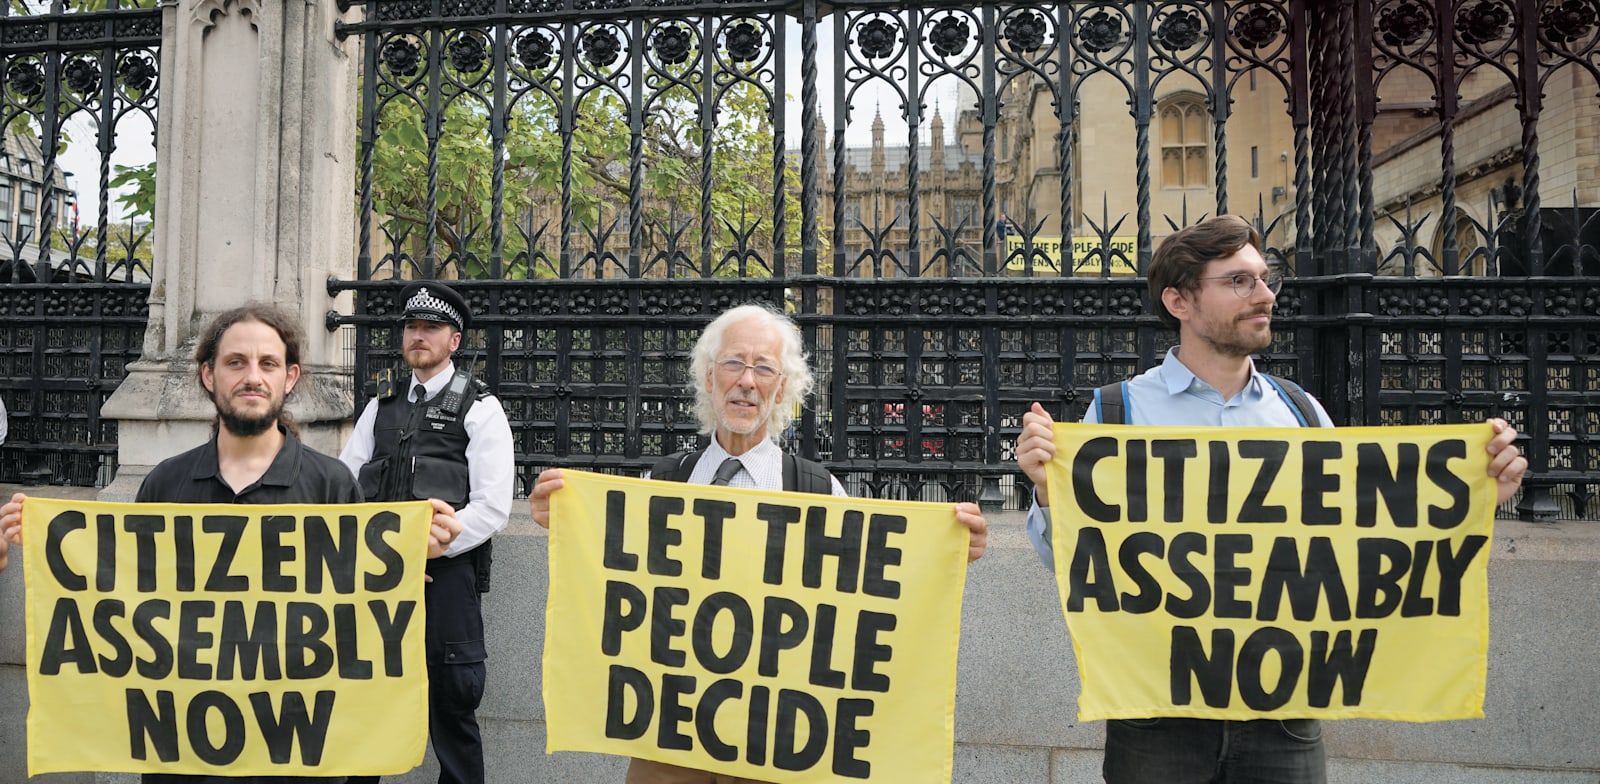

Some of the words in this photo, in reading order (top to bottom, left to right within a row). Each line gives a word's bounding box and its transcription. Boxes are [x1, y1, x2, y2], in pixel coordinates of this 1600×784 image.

[1052, 243, 1093, 253] PPLE
[1097, 242, 1134, 253] DCIDE
[1072, 437, 1471, 530] CITIZENS
[46, 511, 405, 594] CITIZENS
[603, 490, 737, 580] LET
[756, 503, 907, 600] THE
[1067, 527, 1488, 622] ASSEMBLY
[40, 598, 417, 680] ASSEMBLY
[602, 580, 897, 692] PEOPLE
[1170, 626, 1377, 711] NOW
[126, 688, 336, 766] NOW
[605, 665, 874, 779] DECIDE
